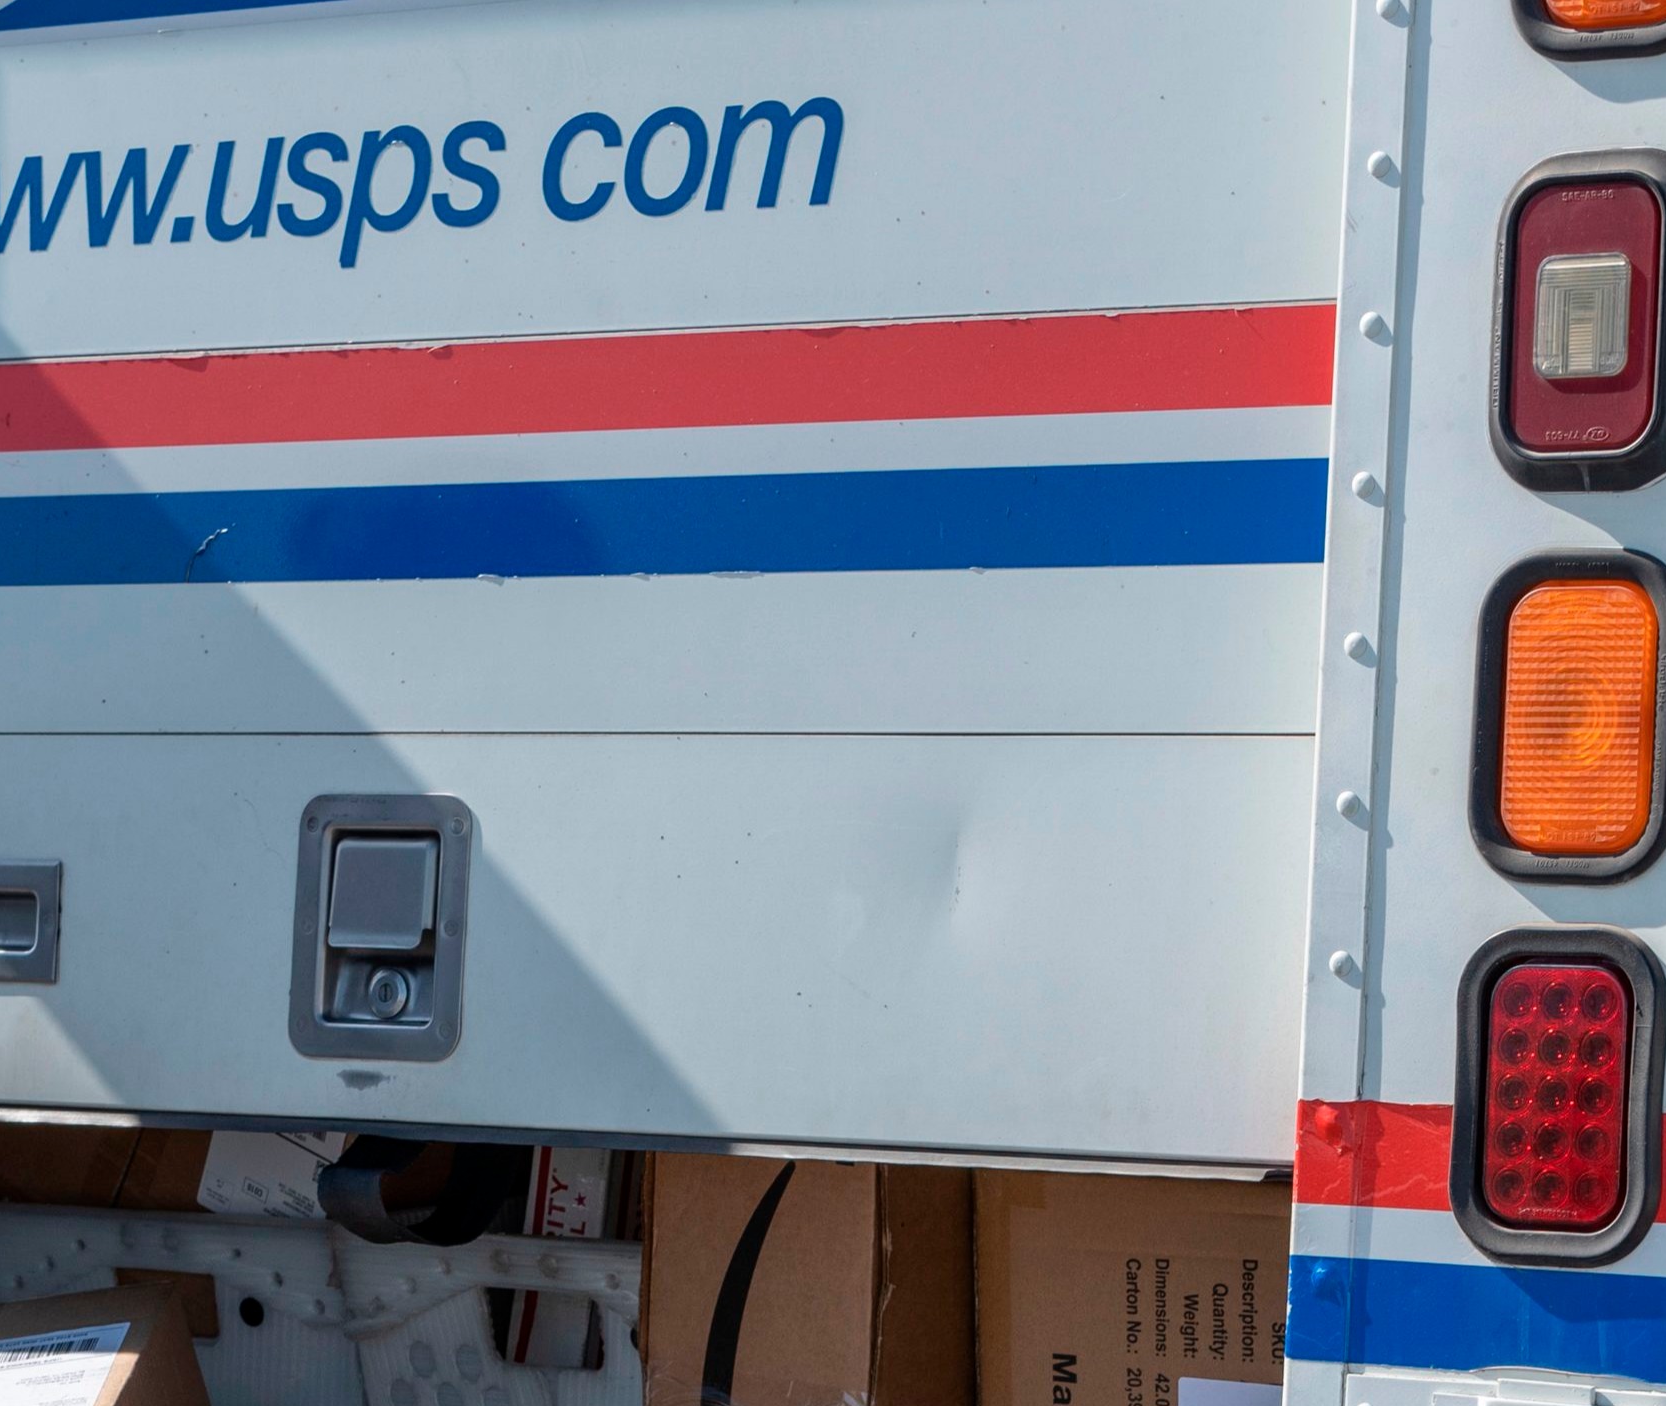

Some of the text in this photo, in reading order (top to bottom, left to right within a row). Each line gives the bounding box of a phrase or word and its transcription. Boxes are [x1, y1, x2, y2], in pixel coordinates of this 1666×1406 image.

[542, 96, 845, 222] com
[1126, 1258, 1142, 1314] Carton
[1155, 1258, 1170, 1358] Dimensions:
[1209, 1283, 1229, 1360] Quantity:
[1239, 1259, 1258, 1363] Description:
[1126, 1321, 1142, 1354] No.:
[1179, 1293, 1199, 1359] Weight:
